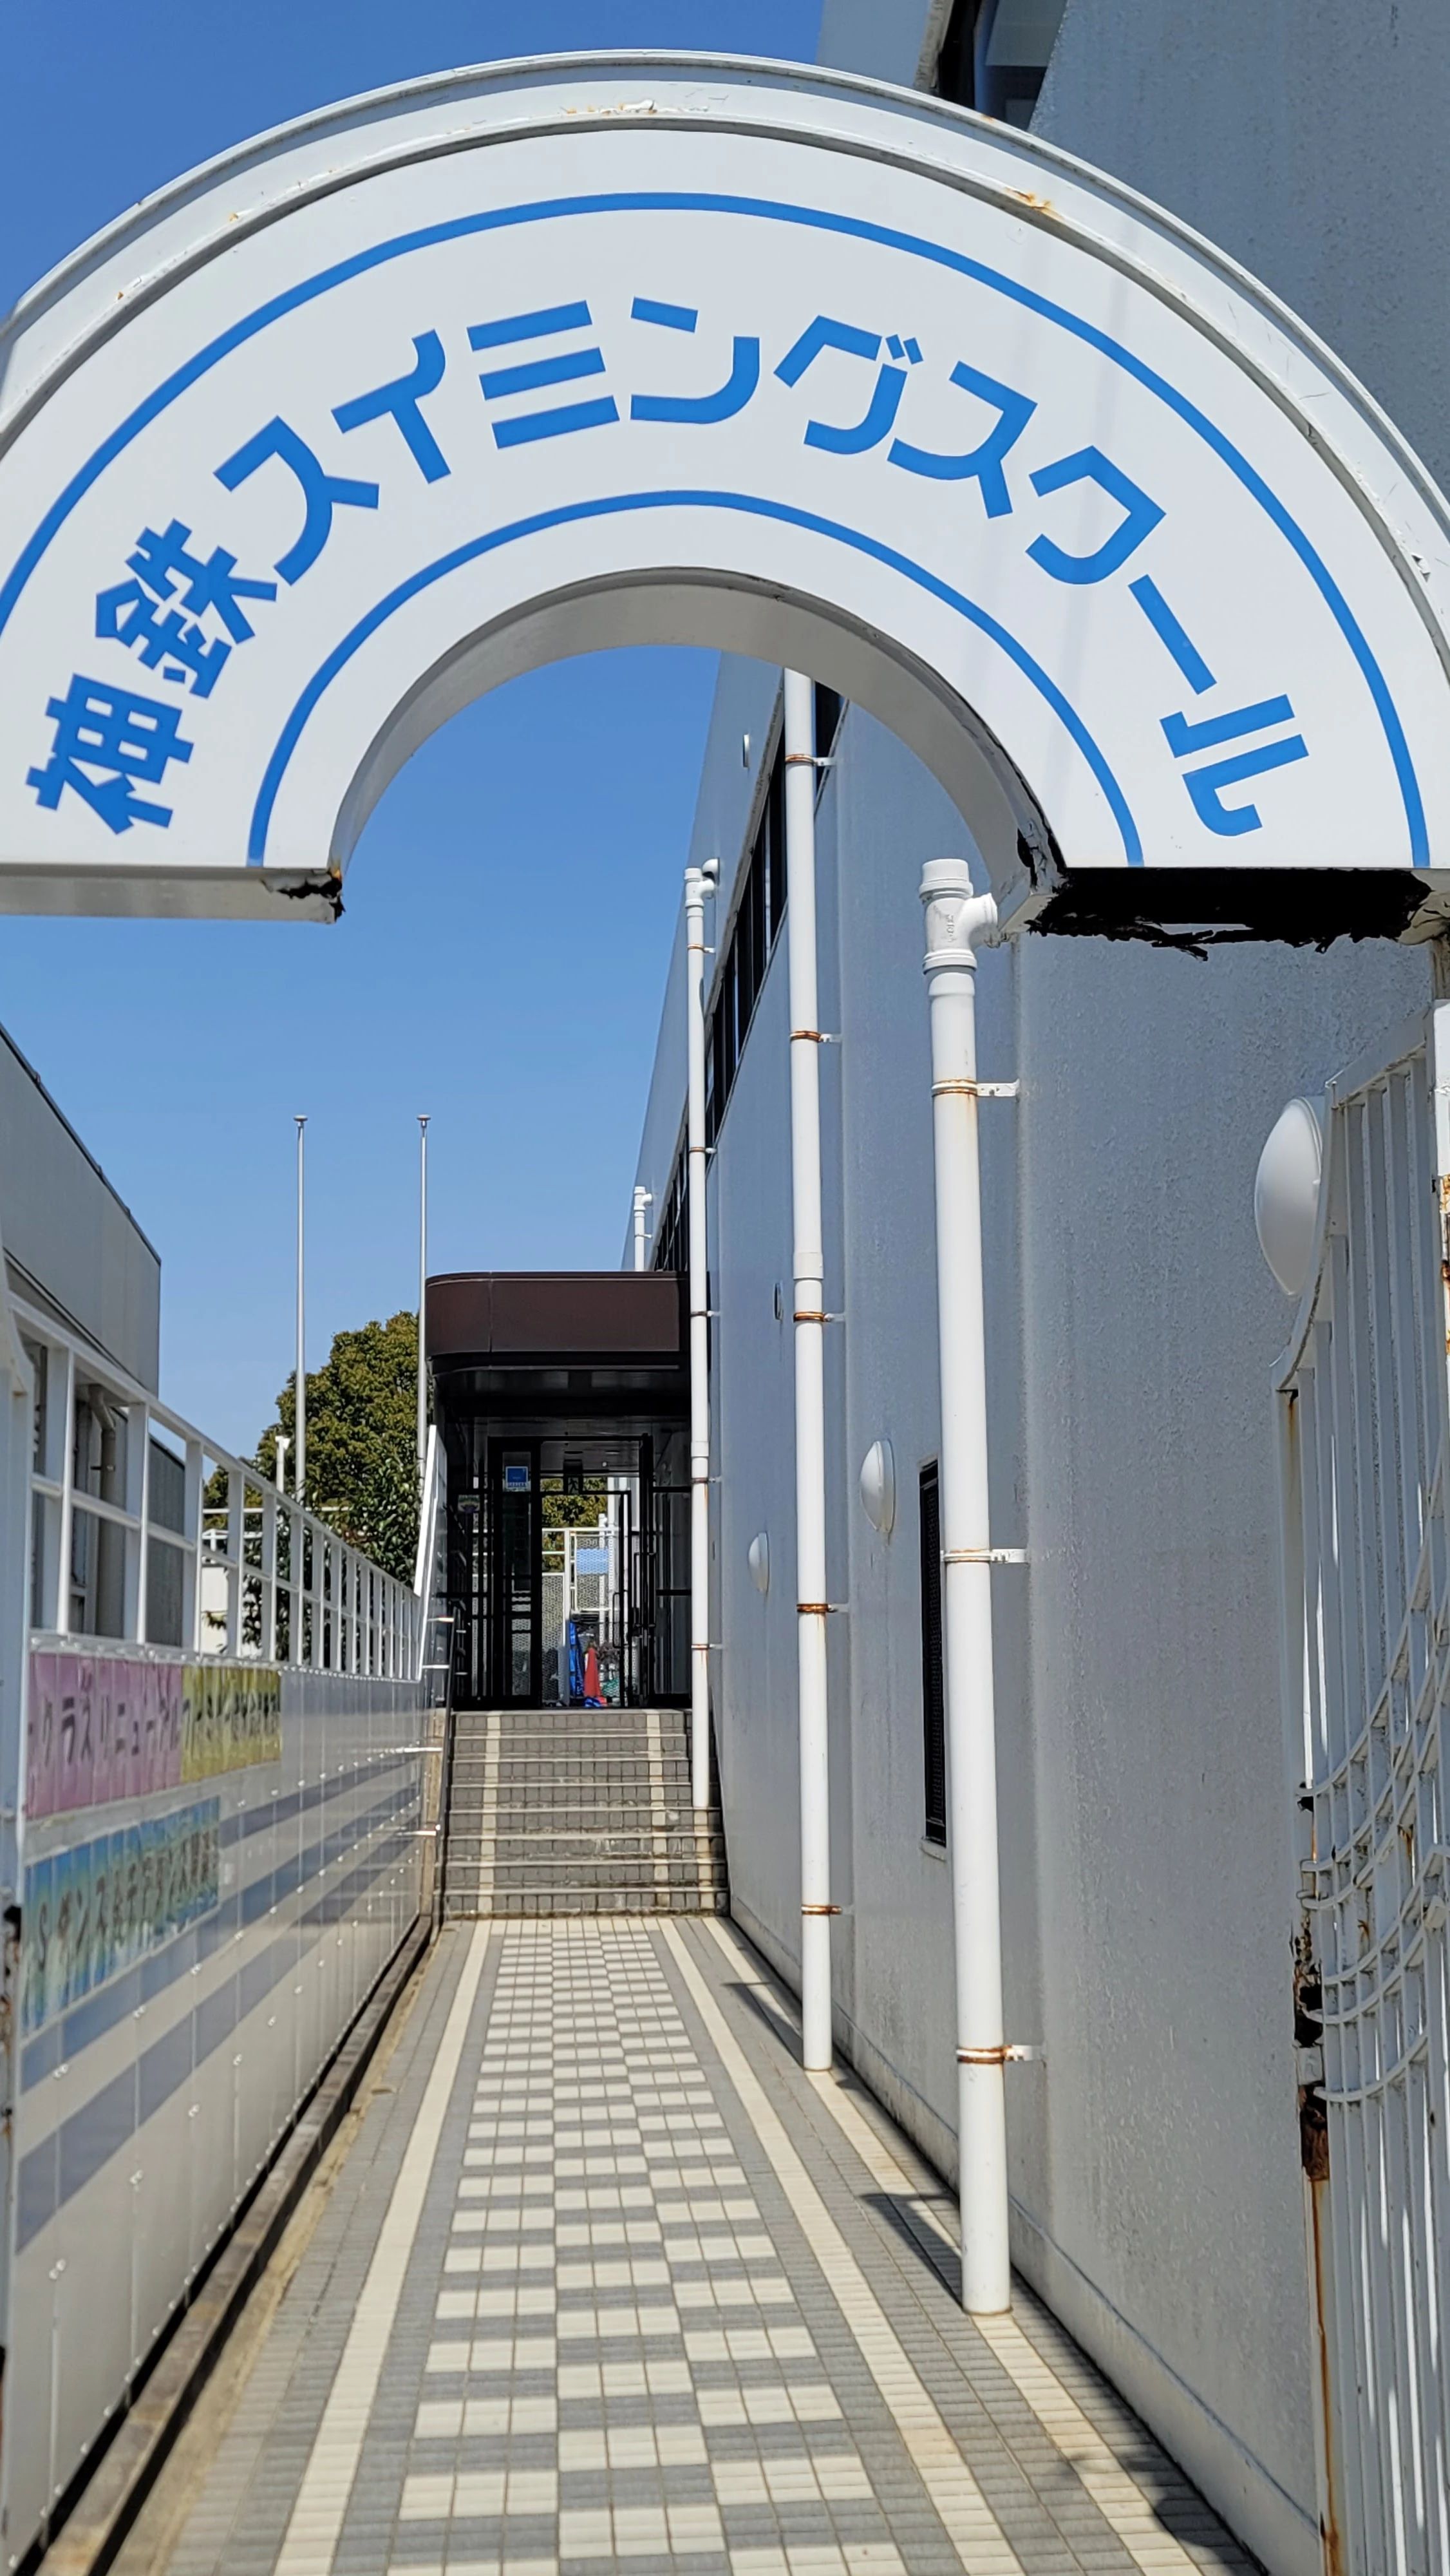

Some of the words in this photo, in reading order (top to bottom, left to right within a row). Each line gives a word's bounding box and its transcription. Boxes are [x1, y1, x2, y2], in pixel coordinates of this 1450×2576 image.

[28, 299, 1308, 836] 神鉄スイミングスクール
